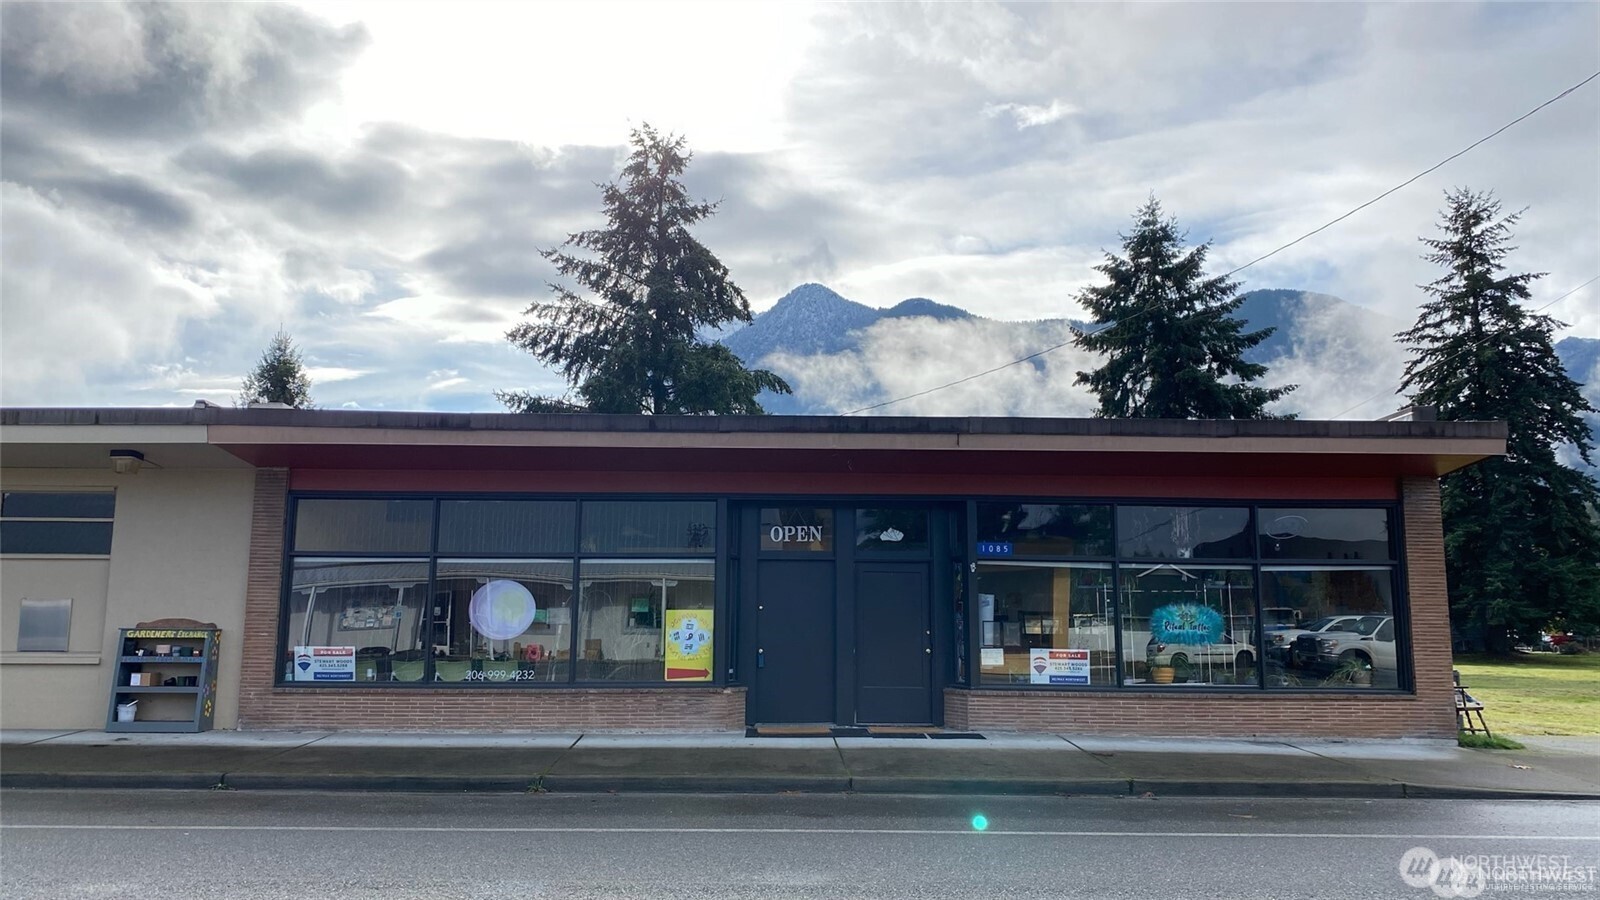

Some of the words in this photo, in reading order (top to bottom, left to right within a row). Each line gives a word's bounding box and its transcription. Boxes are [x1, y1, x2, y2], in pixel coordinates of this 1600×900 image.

[770, 525, 823, 542] OPEN
[982, 544, 1009, 553] 1085
[1164, 620, 1186, 631] Ritual
[465, 669, 535, 680] 206-999-4232
